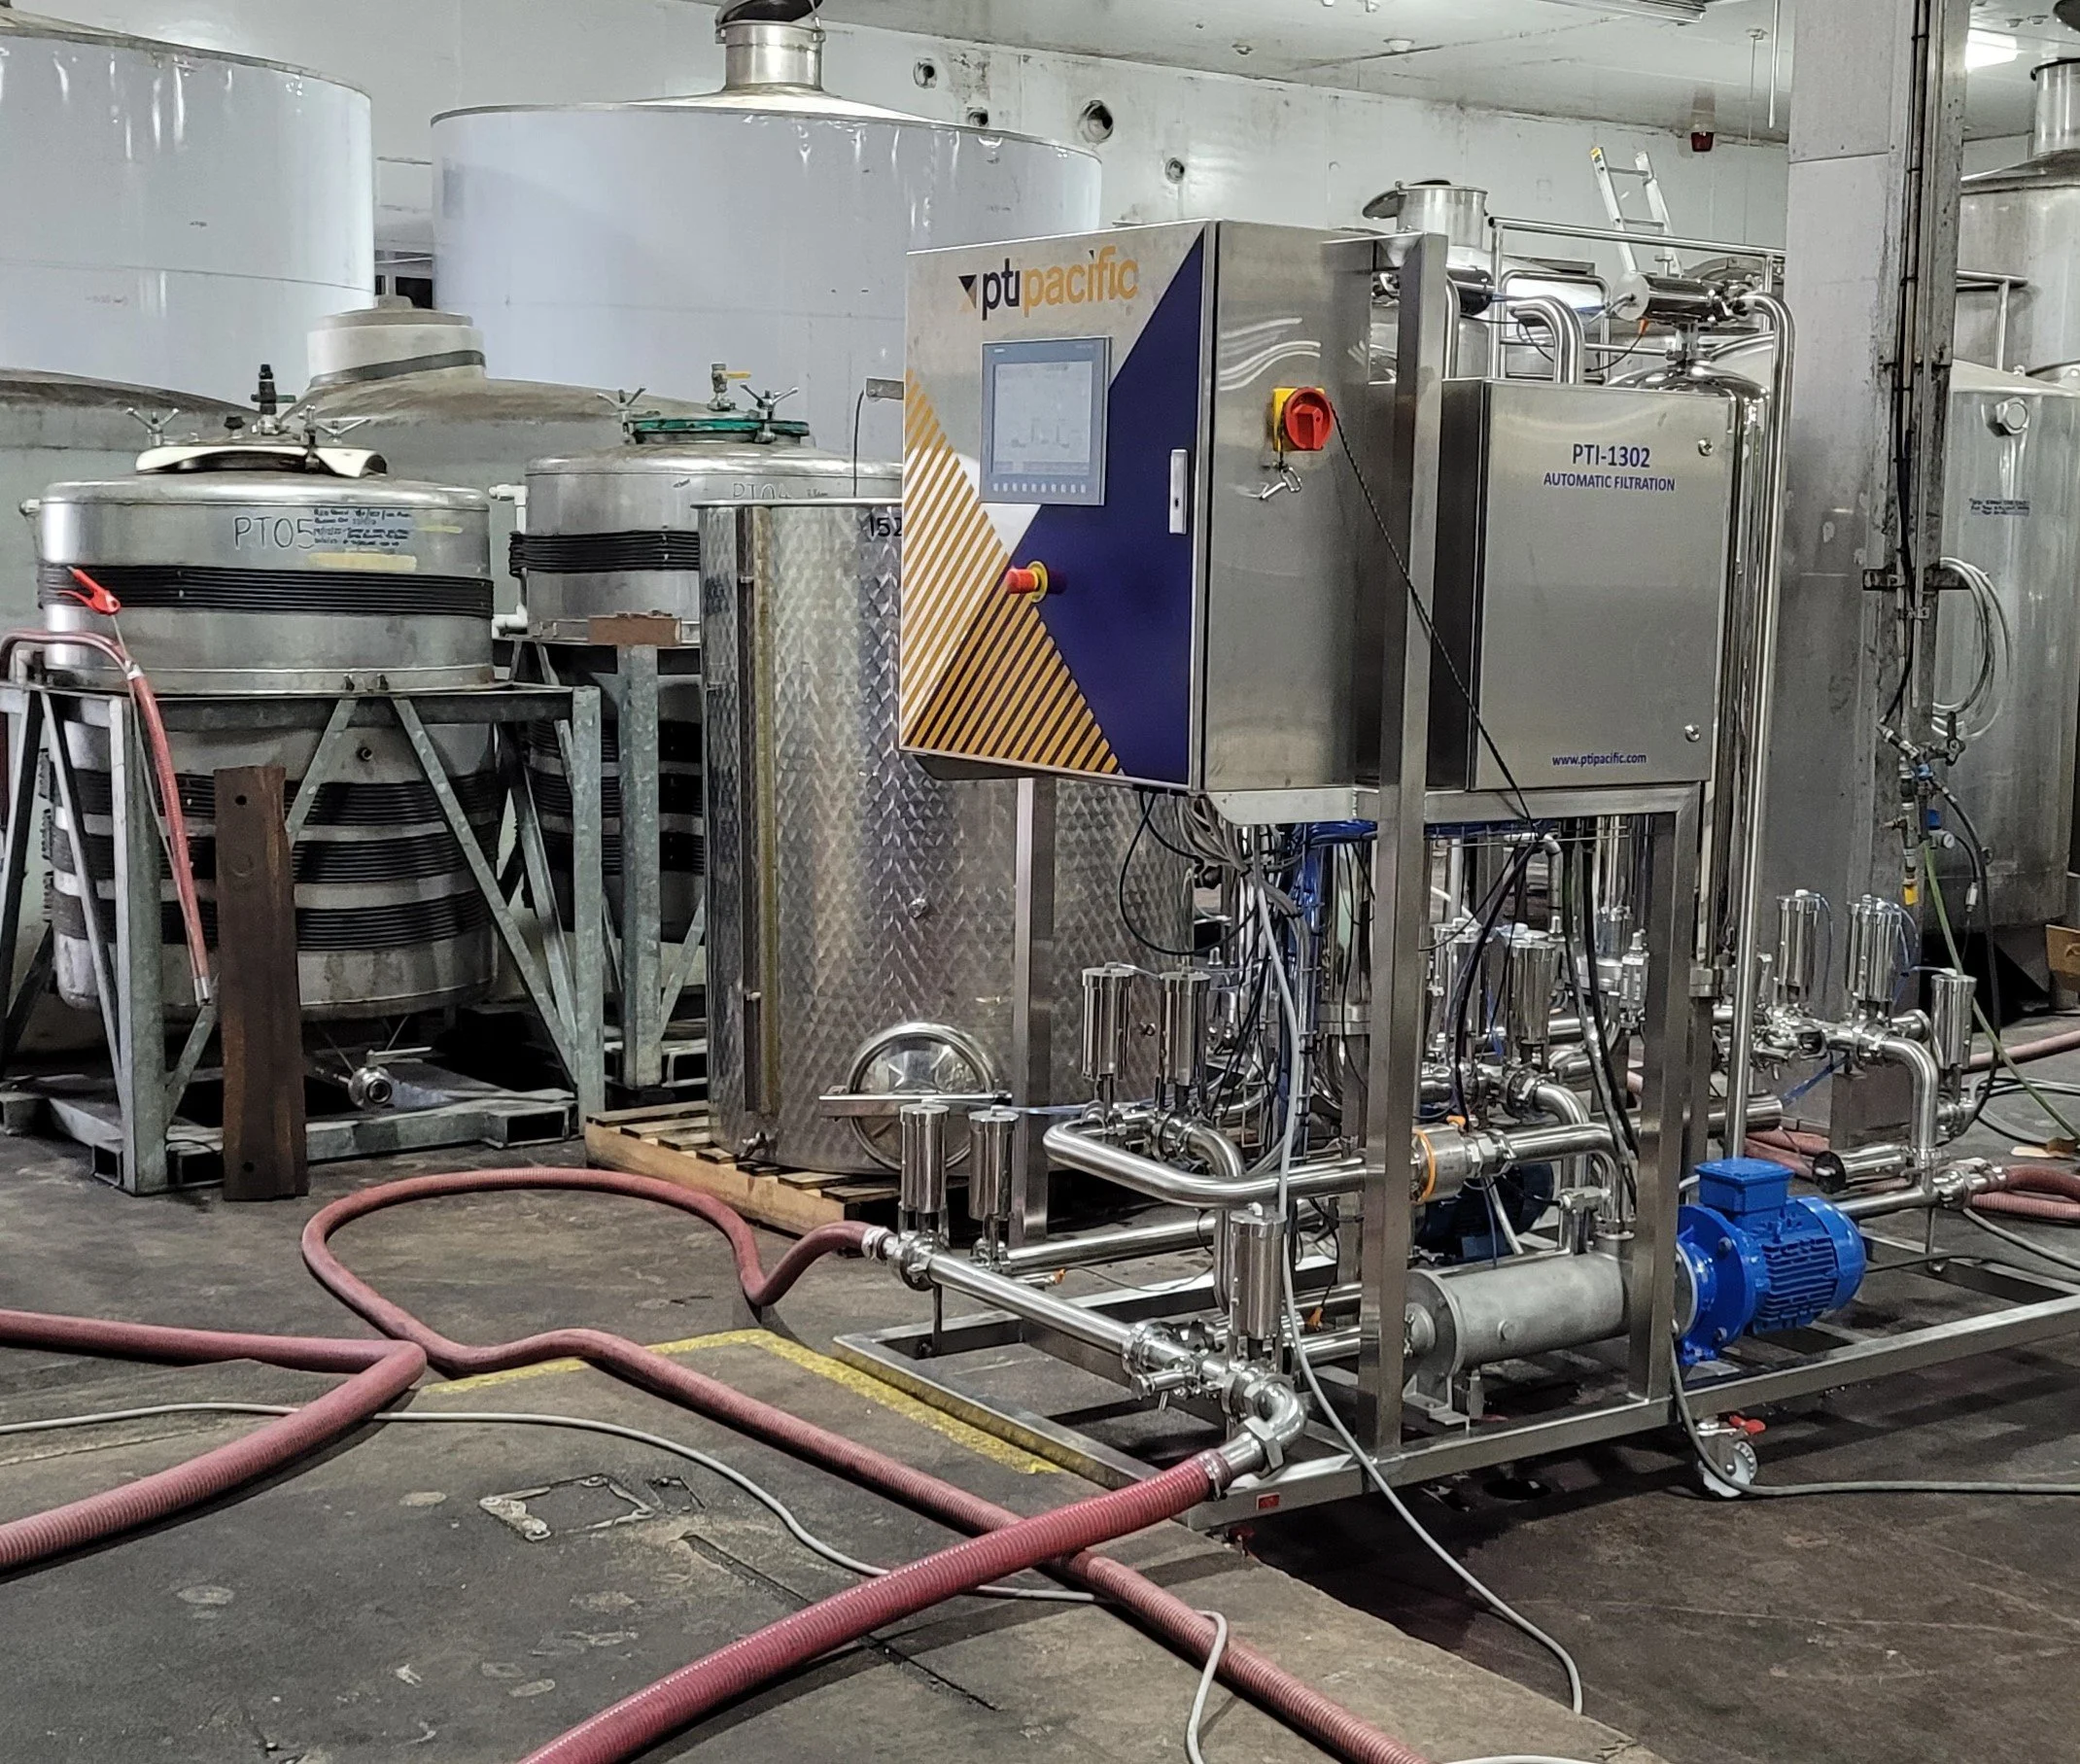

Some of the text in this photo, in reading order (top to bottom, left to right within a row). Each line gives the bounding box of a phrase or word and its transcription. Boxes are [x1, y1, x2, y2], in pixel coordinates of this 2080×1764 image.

[1572, 443, 1650, 468] PTI-1302
[1543, 472, 1676, 492] AUTOMATIC FILTRATION
[1551, 751, 1647, 768] www.ptipacific.com
